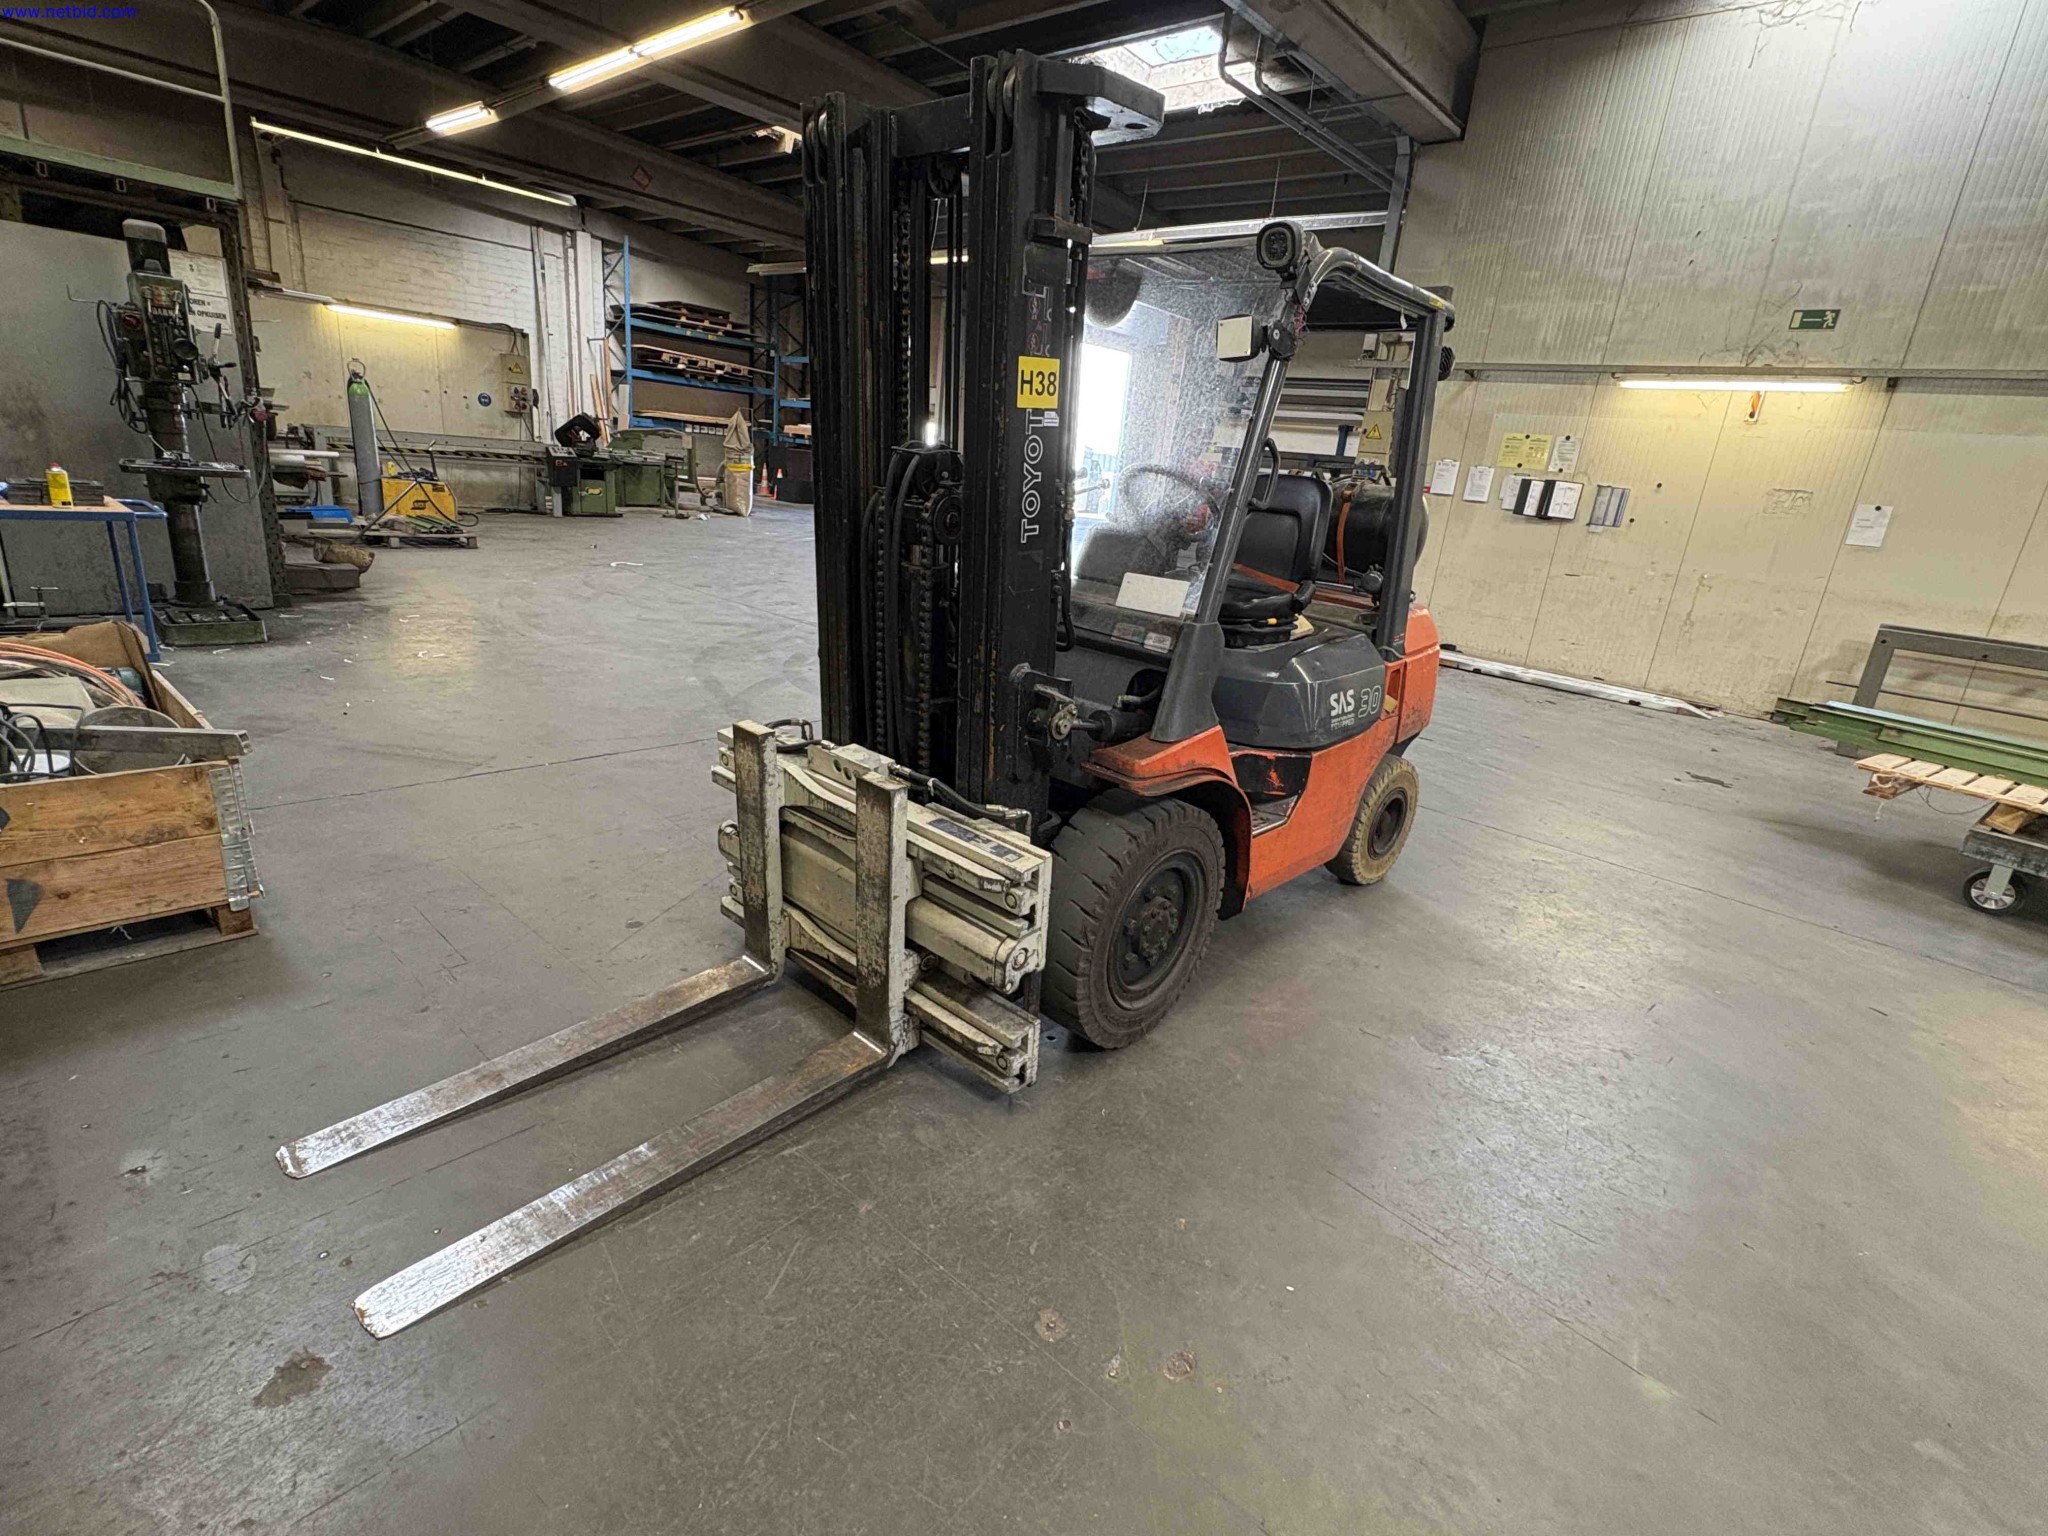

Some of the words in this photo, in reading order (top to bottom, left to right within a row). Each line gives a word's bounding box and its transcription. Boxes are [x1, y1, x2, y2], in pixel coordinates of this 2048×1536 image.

[1020, 369, 1057, 397] H38
[1020, 408, 1044, 544] TOYOT
[1329, 688, 1355, 717] SAS
[1357, 684, 1382, 719] 30
